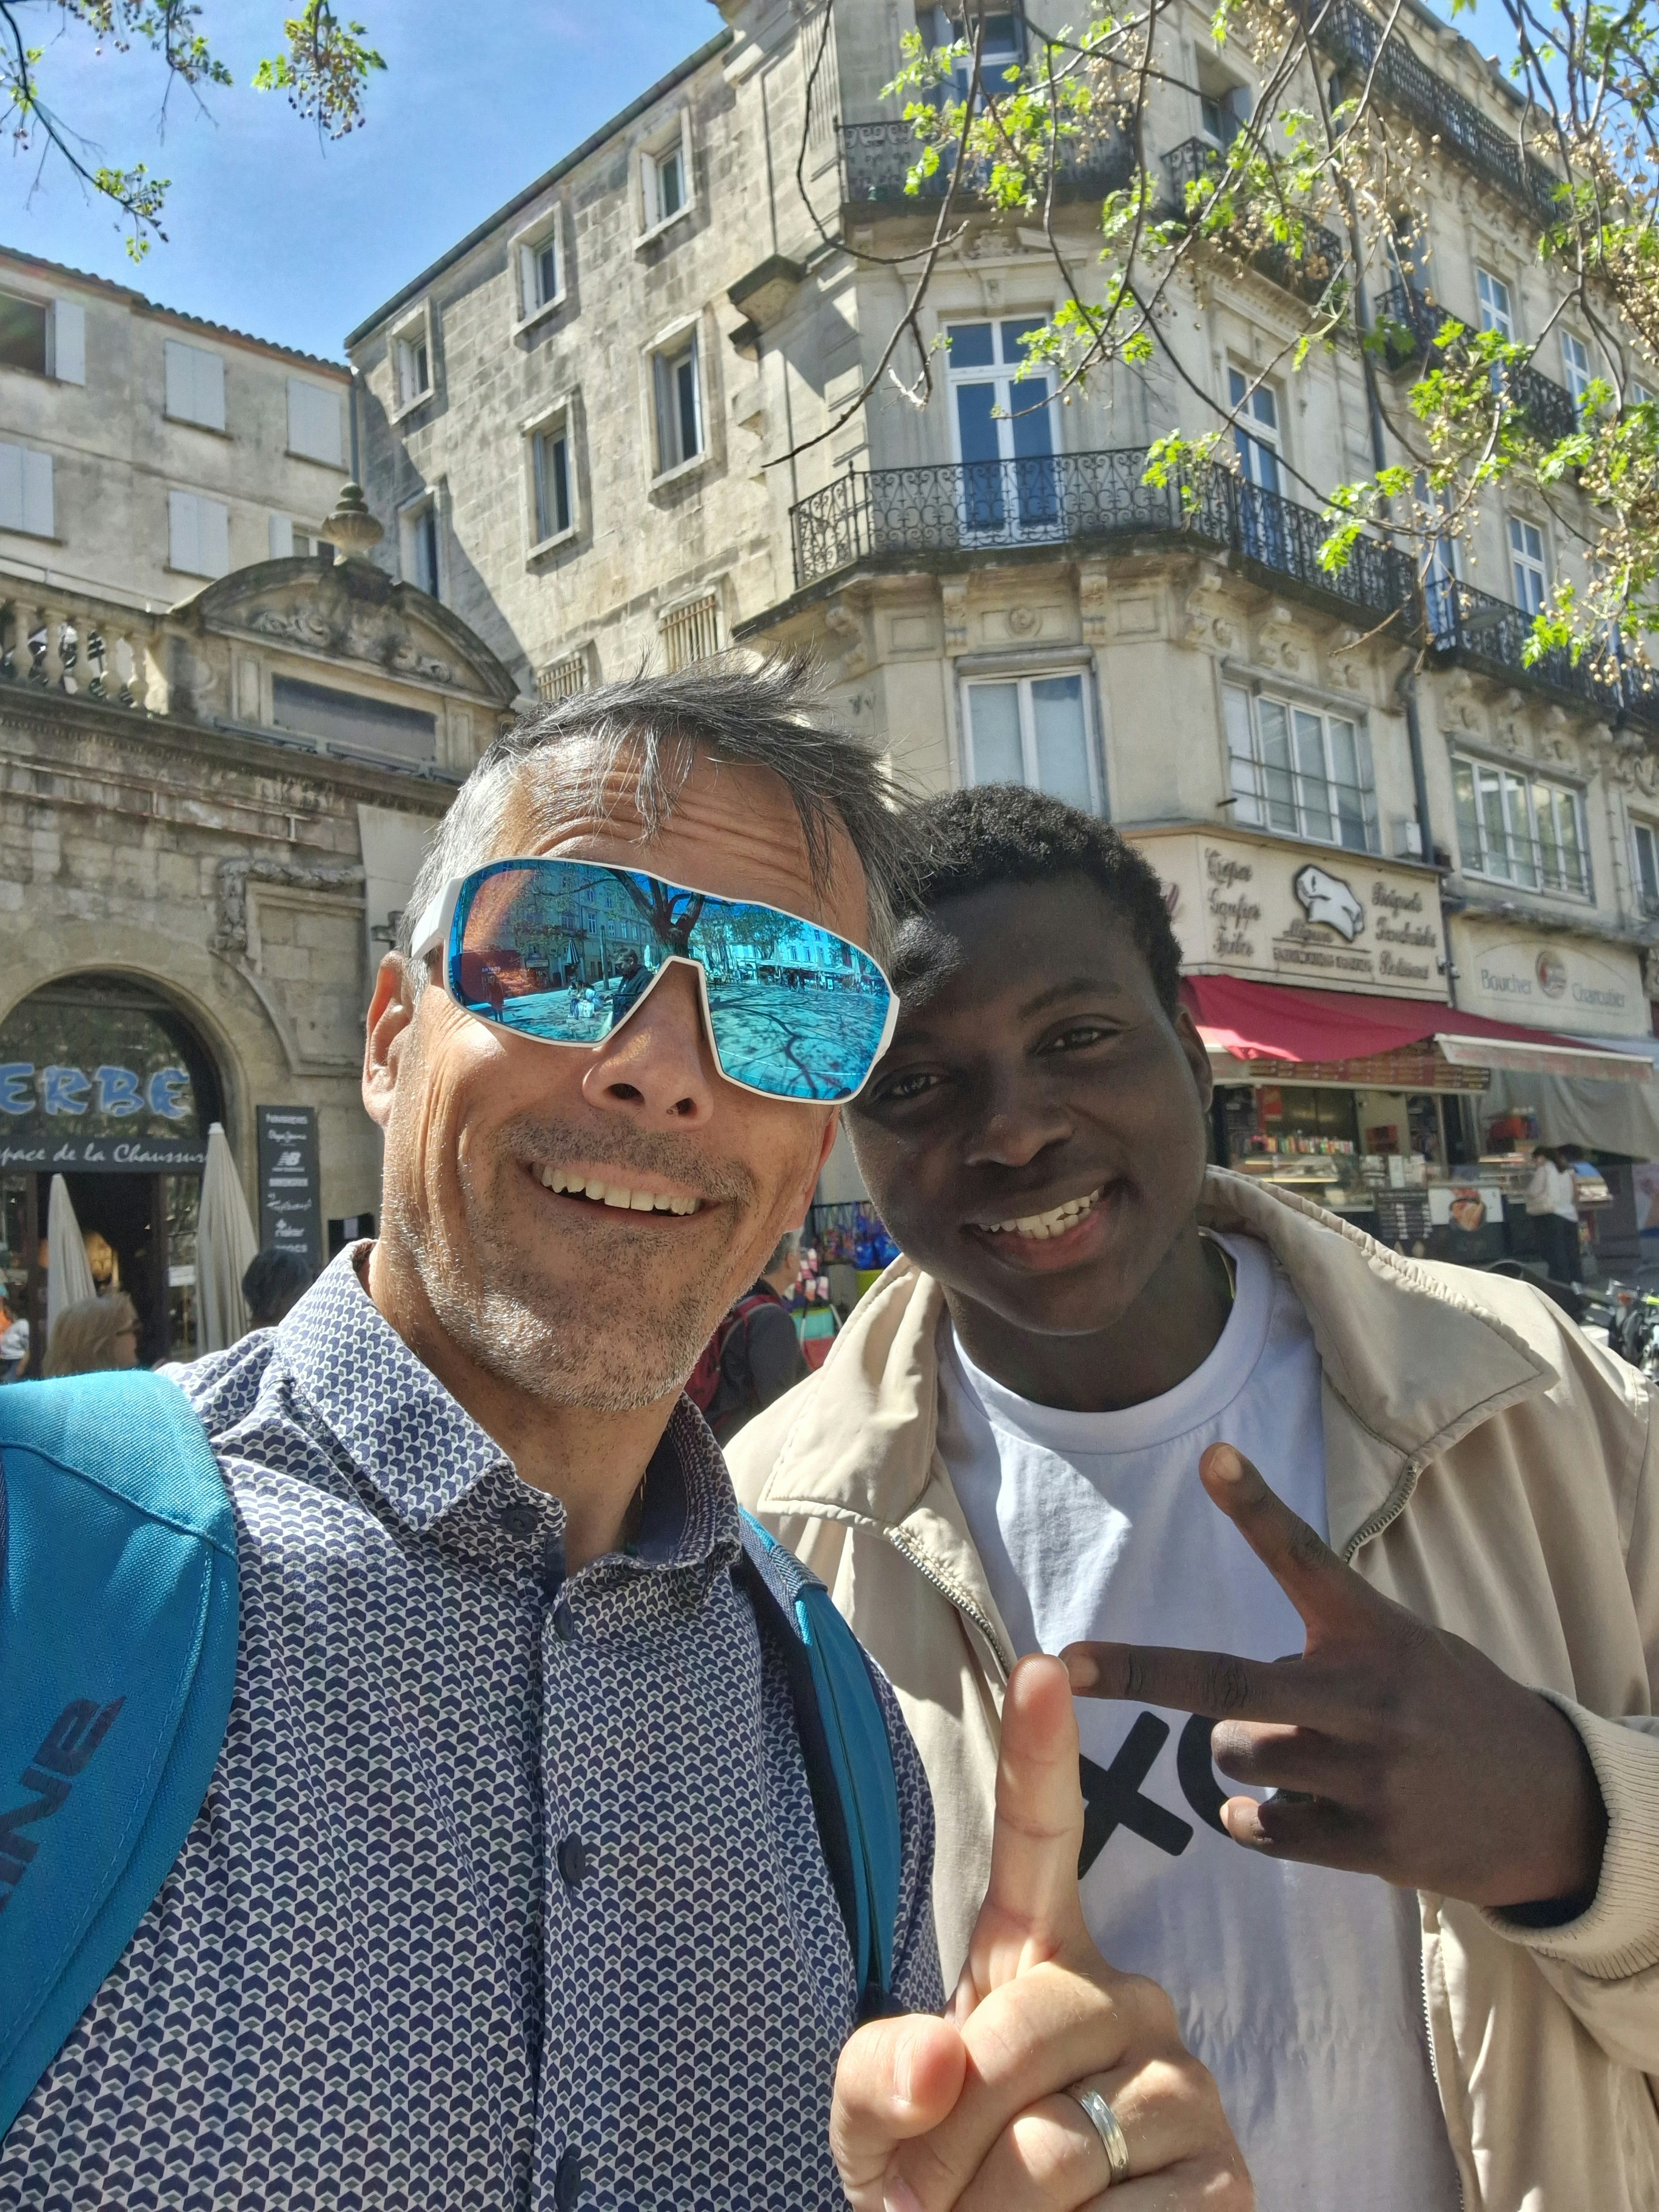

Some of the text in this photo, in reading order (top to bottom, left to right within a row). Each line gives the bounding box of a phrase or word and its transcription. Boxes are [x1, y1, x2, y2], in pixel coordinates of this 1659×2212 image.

[53, 1141, 76, 1162] de
[82, 1142, 106, 1162] la
[113, 1143, 207, 1164] Chaussur
